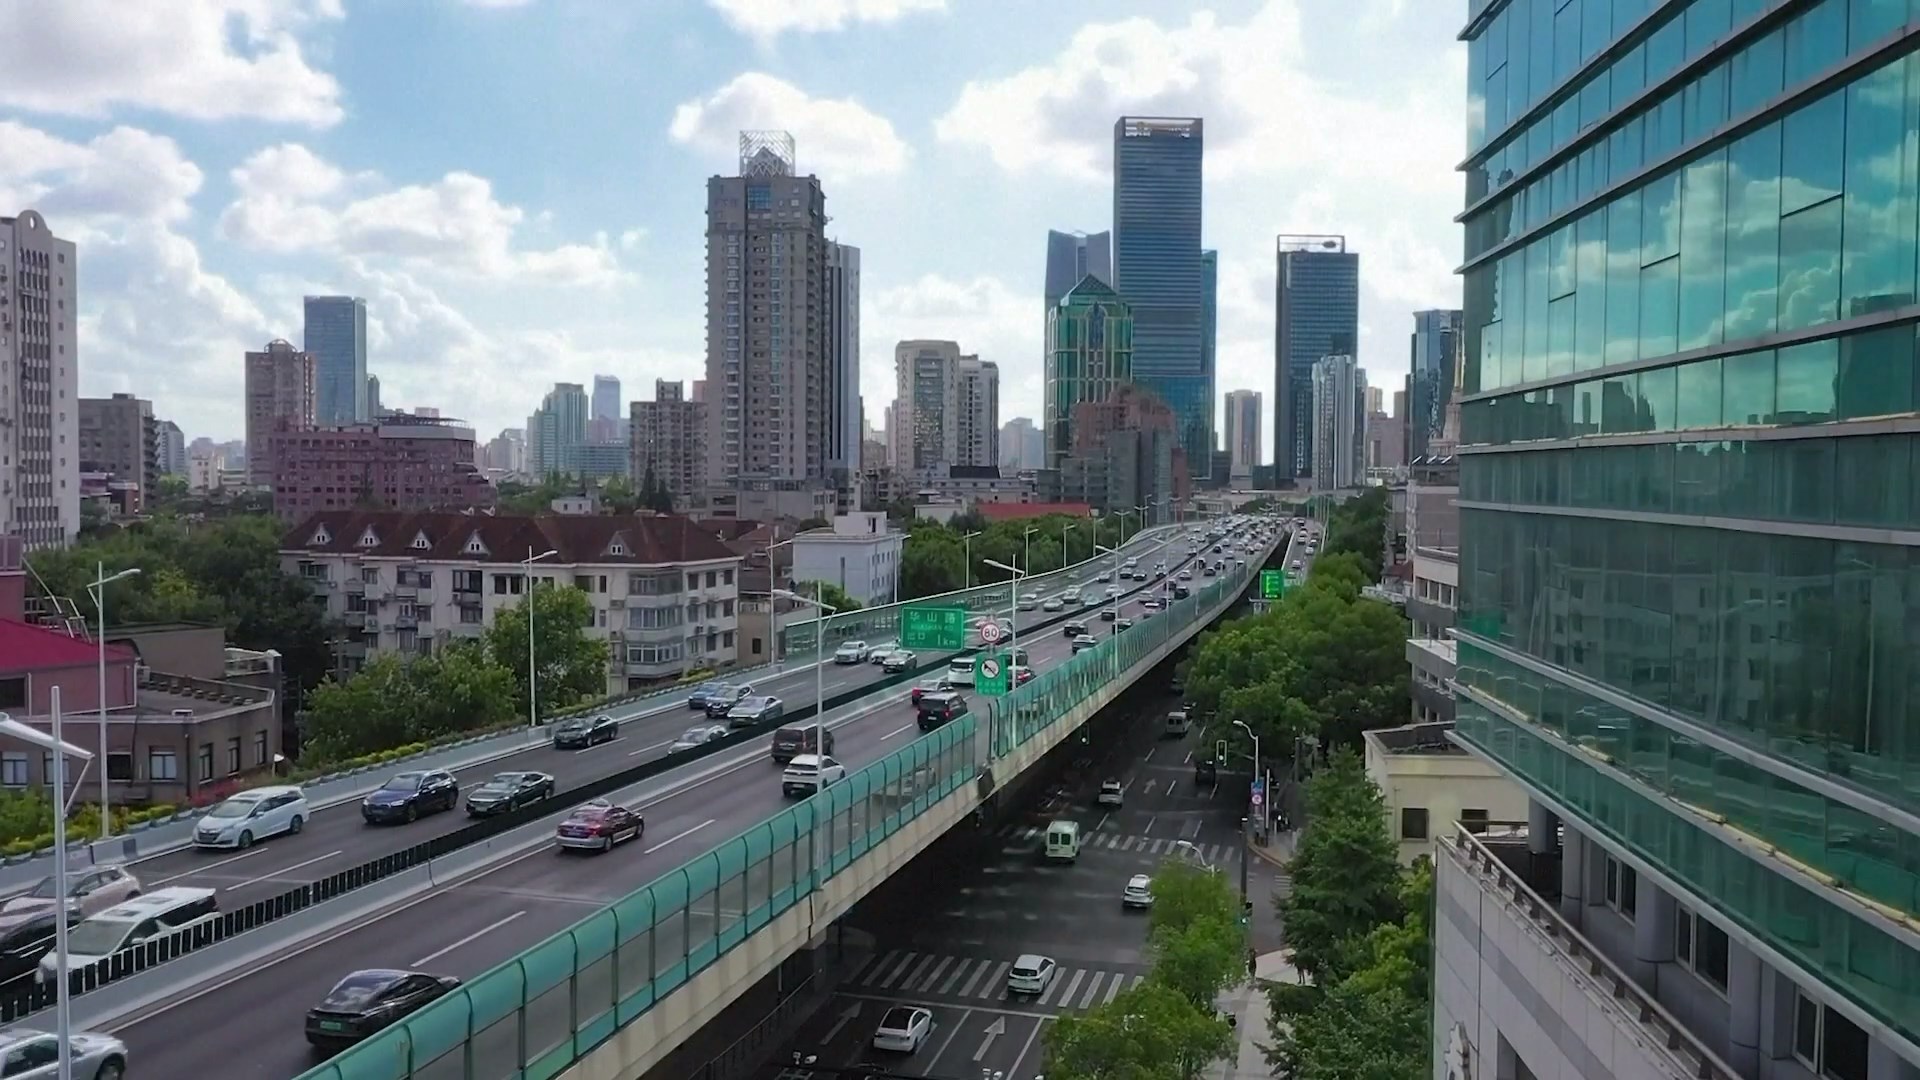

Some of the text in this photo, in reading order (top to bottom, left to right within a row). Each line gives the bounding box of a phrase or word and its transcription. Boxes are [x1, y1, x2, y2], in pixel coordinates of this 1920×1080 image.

[910, 611, 955, 624] 华山路
[984, 627, 997, 637] 80
